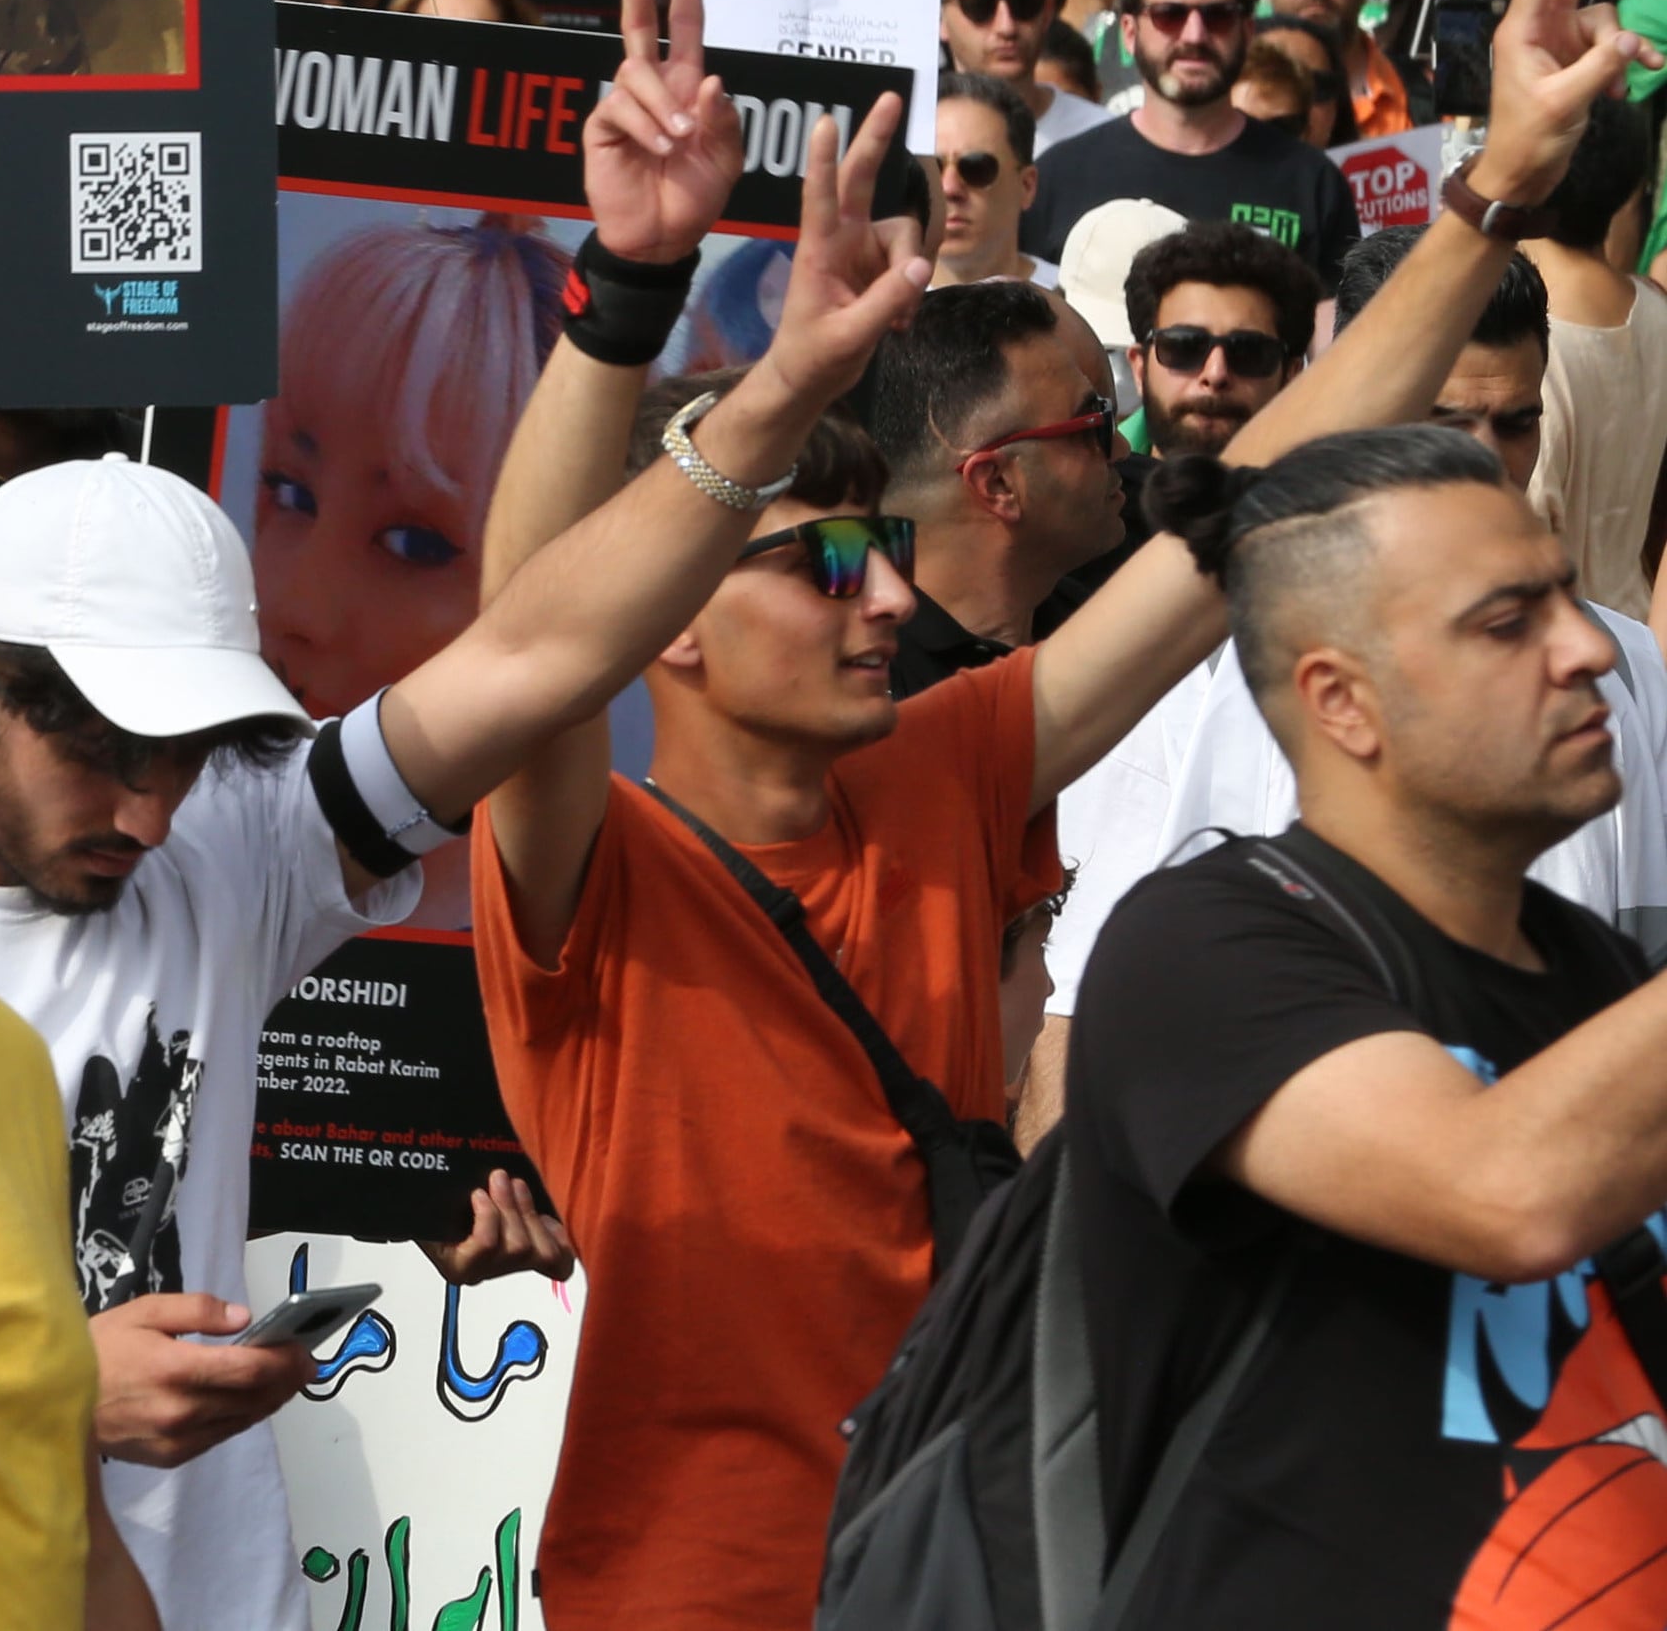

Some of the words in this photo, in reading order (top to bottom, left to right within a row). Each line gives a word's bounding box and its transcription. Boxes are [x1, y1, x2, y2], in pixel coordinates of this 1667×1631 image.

[468, 67, 585, 156] LIFE
[122, 279, 160, 298] STAGE
[161, 279, 180, 298] OF
[122, 297, 179, 315] FREEDOM
[301, 1035, 313, 1047] a
[317, 1031, 381, 1056] rooftop
[314, 1052, 330, 1069] in
[335, 1054, 385, 1076] Rabat
[389, 1059, 441, 1079] Karim
[302, 1075, 351, 1096] 2022.
[272, 1119, 321, 1138] about
[326, 1123, 377, 1143] Bahar
[382, 1127, 415, 1145] and
[419, 1130, 464, 1150] other
[280, 1142, 329, 1162] SCAN
[333, 1145, 364, 1165] THE
[368, 1149, 394, 1168] QR
[398, 1151, 450, 1171] CODE.
